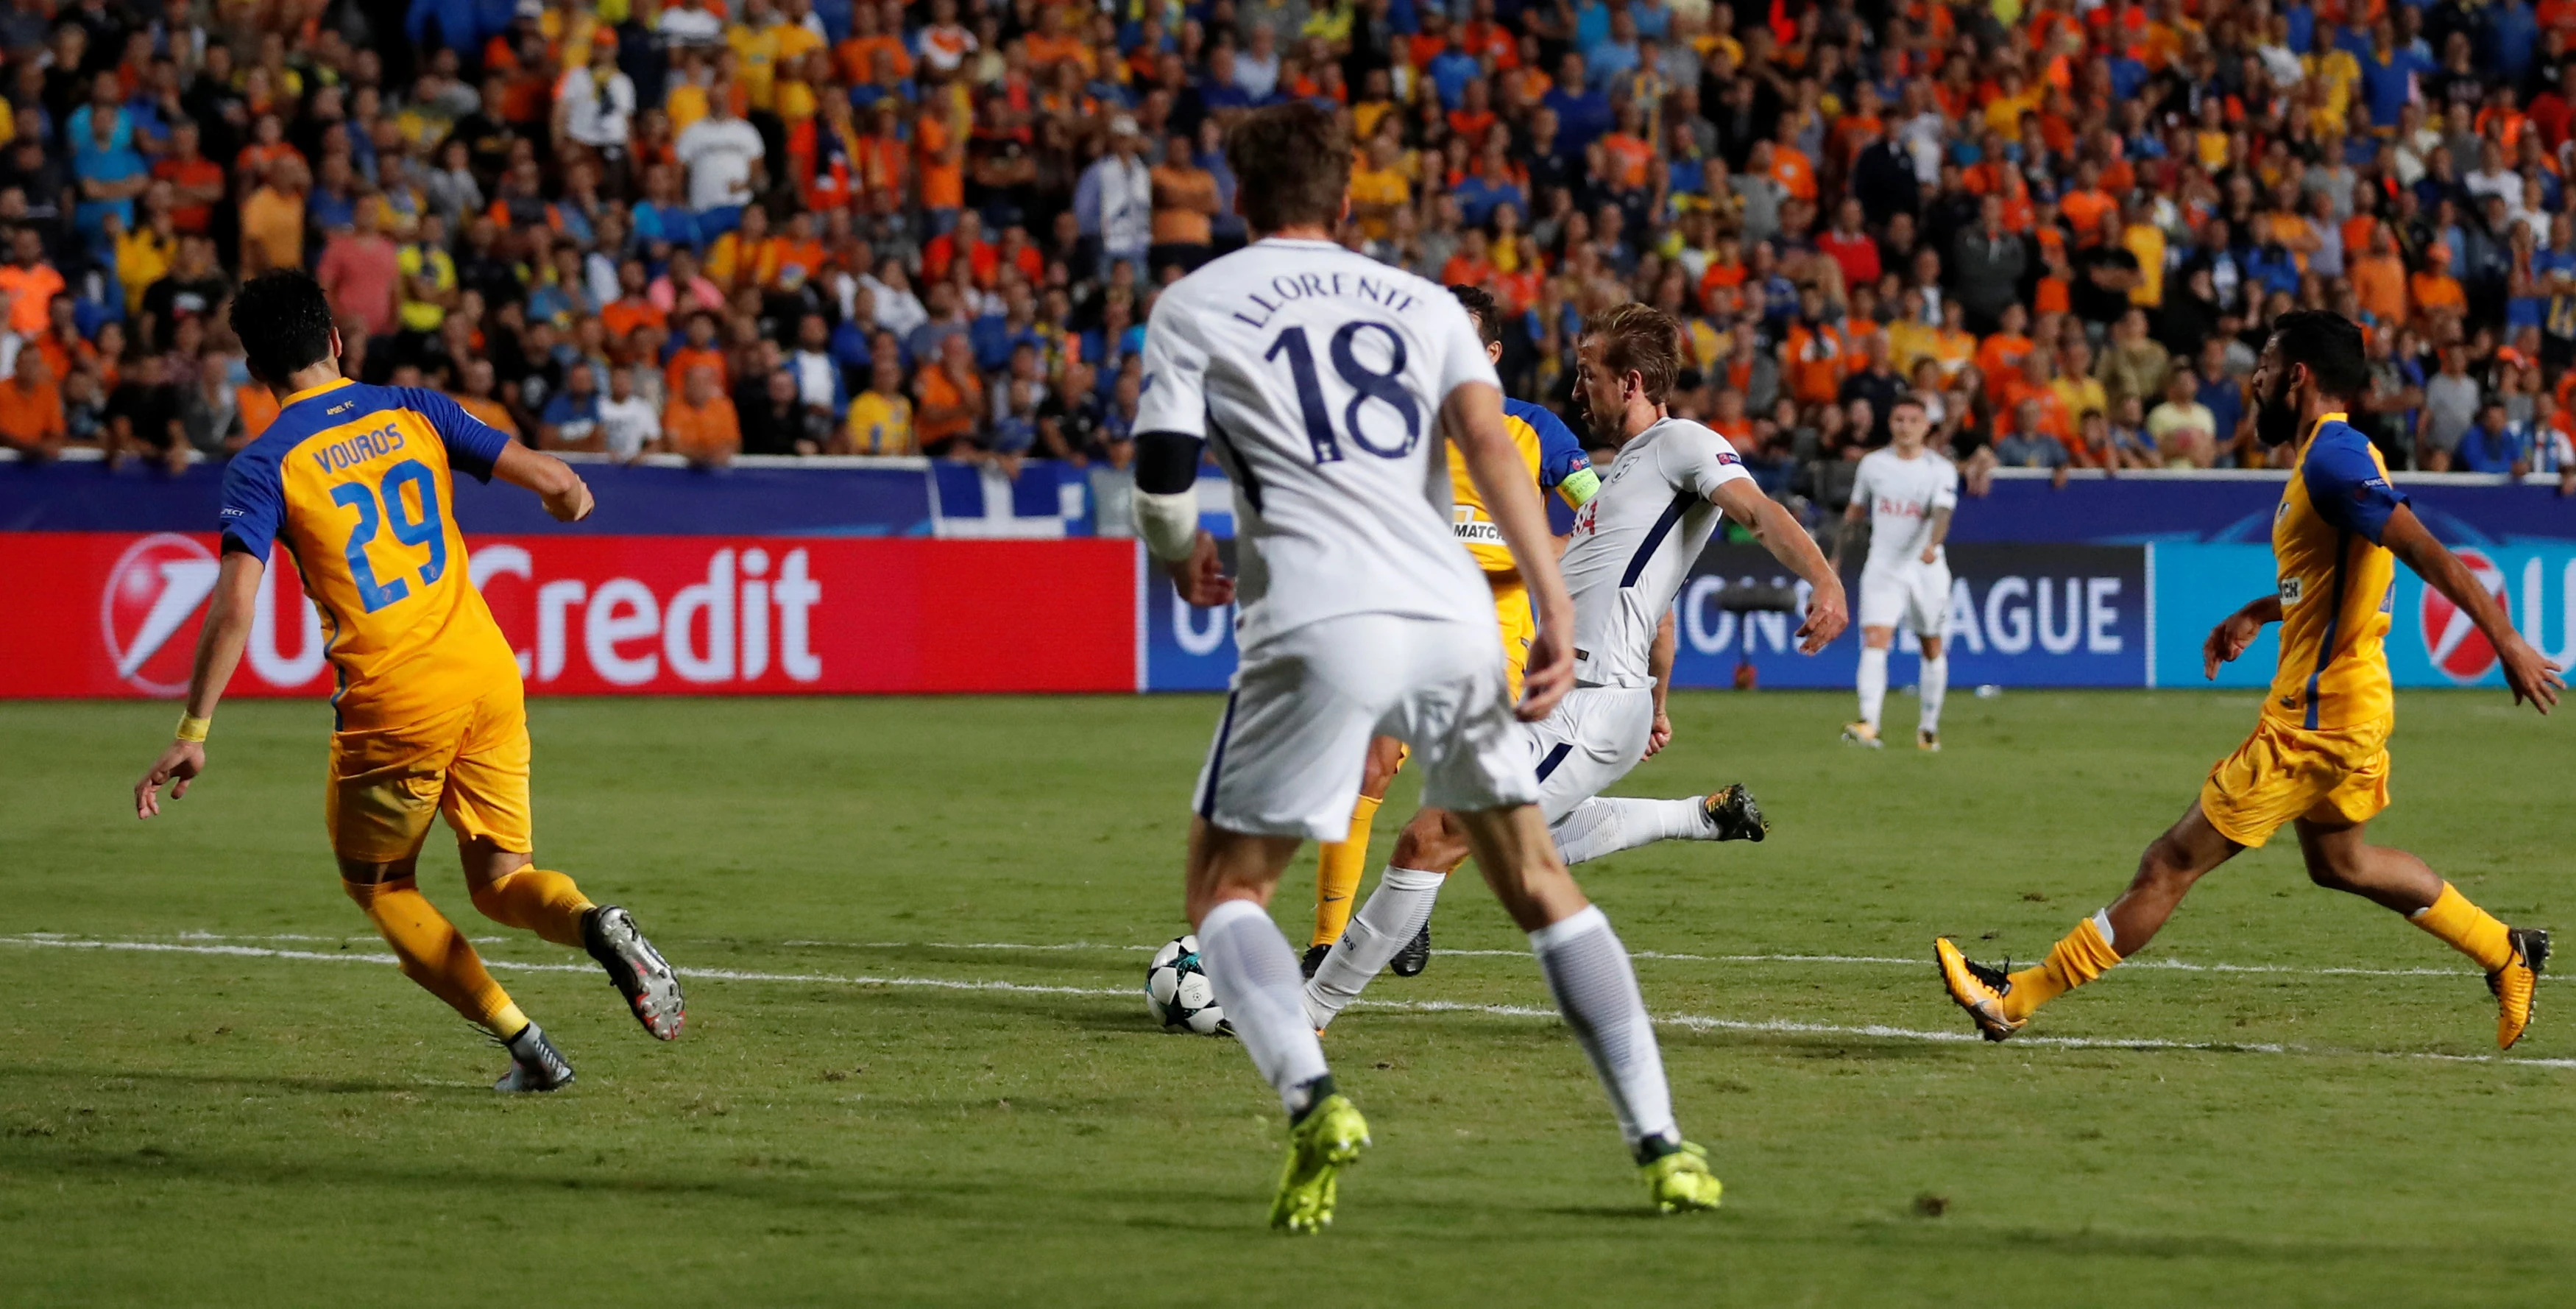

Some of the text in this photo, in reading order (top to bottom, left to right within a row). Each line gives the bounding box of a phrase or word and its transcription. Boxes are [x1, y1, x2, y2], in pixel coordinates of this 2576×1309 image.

[1233, 271, 1425, 329] LLORENTE
[344, 400, 355, 409] FC
[1264, 320, 1420, 465] 18
[312, 422, 406, 475] VOUROS
[329, 458, 447, 614] 29
[246, 543, 822, 687] UCredit
[1899, 575, 2123, 655] AGUE
